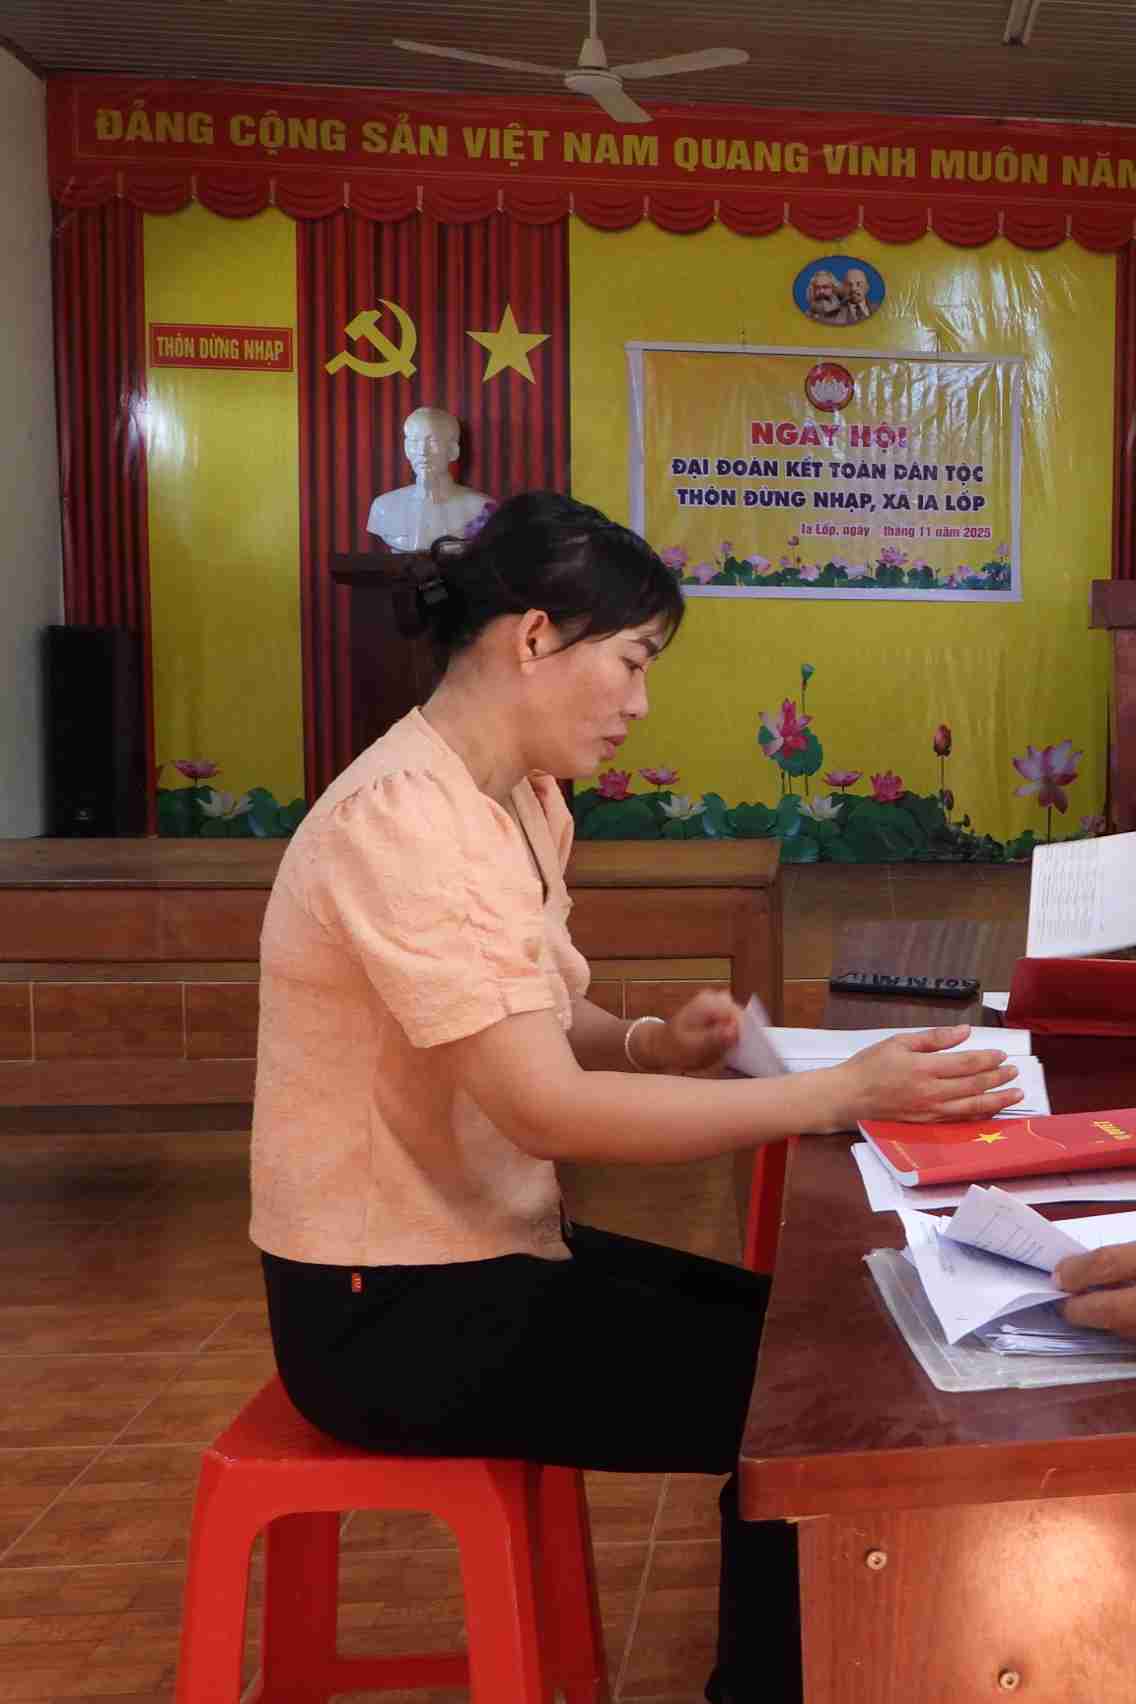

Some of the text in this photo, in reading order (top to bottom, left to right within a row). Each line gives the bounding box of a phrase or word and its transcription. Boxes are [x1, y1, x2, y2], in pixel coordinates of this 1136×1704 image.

[95, 99, 214, 144] ĐẢNG
[229, 110, 346, 155] CỘNG
[361, 112, 448, 157] SẢN
[462, 123, 550, 168] VIỆT
[563, 131, 659, 166] NAM
[674, 136, 808, 173] QUANG
[823, 144, 917, 177] VINH
[930, 146, 1048, 184] MUÔN
[157, 332, 194, 359] THÔN
[243, 338, 284, 367] NHẠP
[672, 458, 709, 479] ĐẠI
[716, 457, 778, 477] ĐOÀN
[785, 457, 823, 478] KẾT
[894, 461, 938, 481] DÂN
[945, 462, 984, 486] TỘC
[677, 486, 736, 506] THÔN
[917, 494, 939, 511] IA
[945, 490, 985, 511] LỐP
[920, 527, 931, 536] 11
[963, 527, 991, 537] 2025
